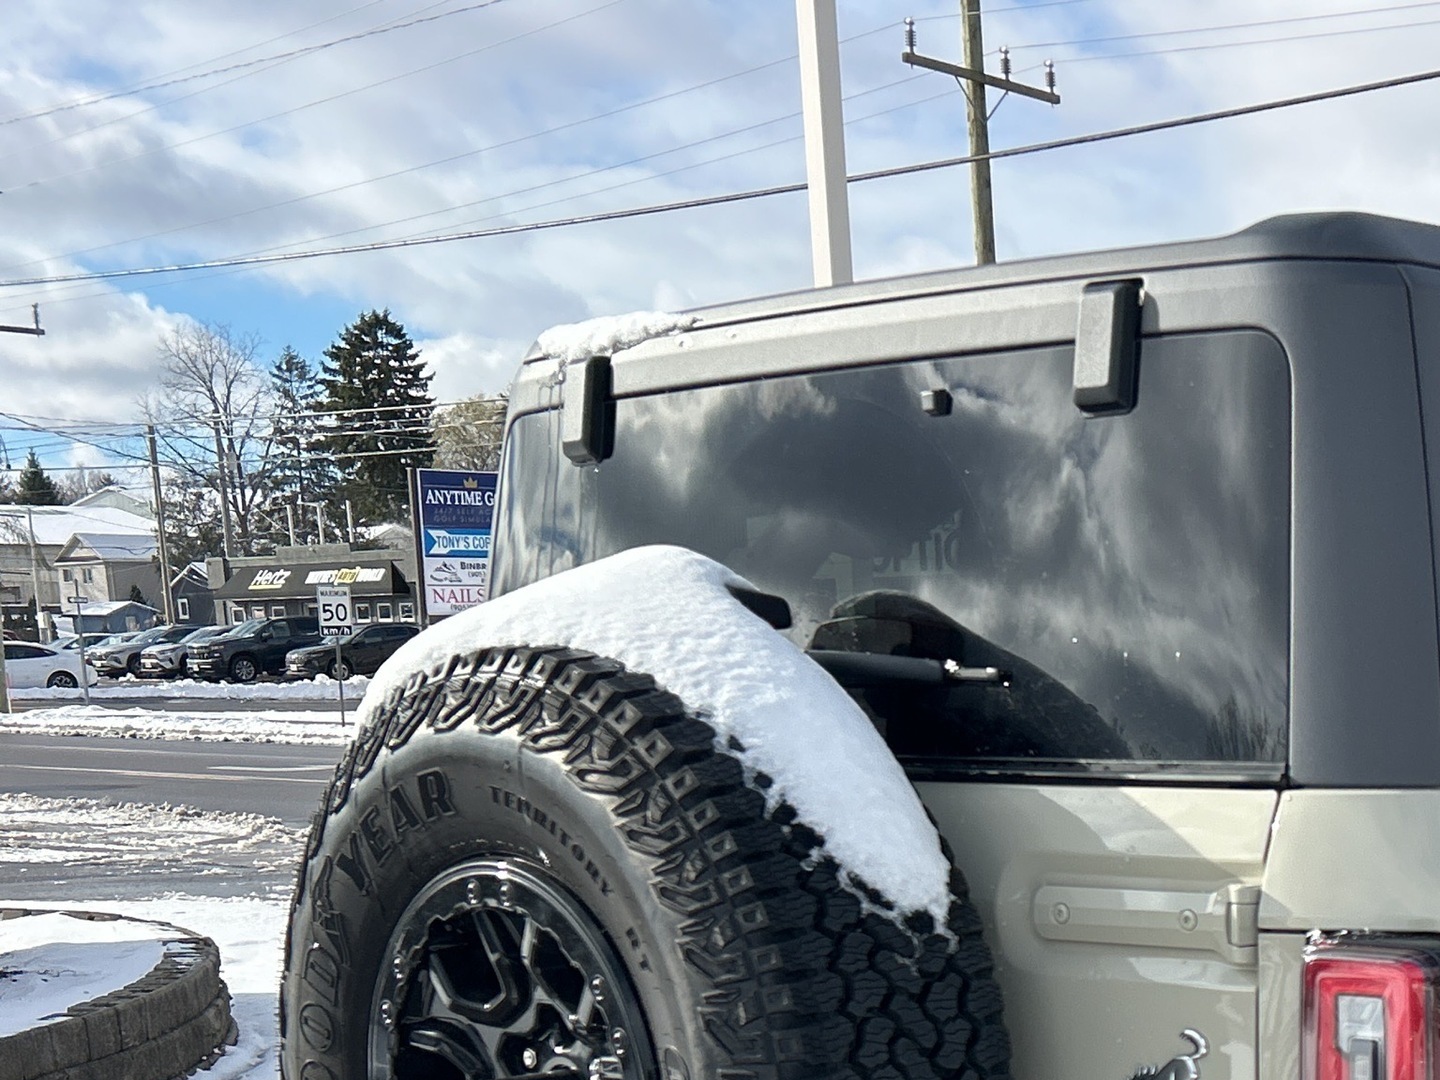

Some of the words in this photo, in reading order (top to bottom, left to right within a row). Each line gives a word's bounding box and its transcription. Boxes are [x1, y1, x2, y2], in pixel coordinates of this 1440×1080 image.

[426, 489, 482, 505] ANYTIME
[436, 535, 470, 549] TONY'S
[250, 569, 292, 586] Hertz
[432, 588, 485, 603] NAILS
[322, 603, 348, 622] 50
[323, 627, 351, 636] km/h
[489, 785, 614, 897] TERRITORY
